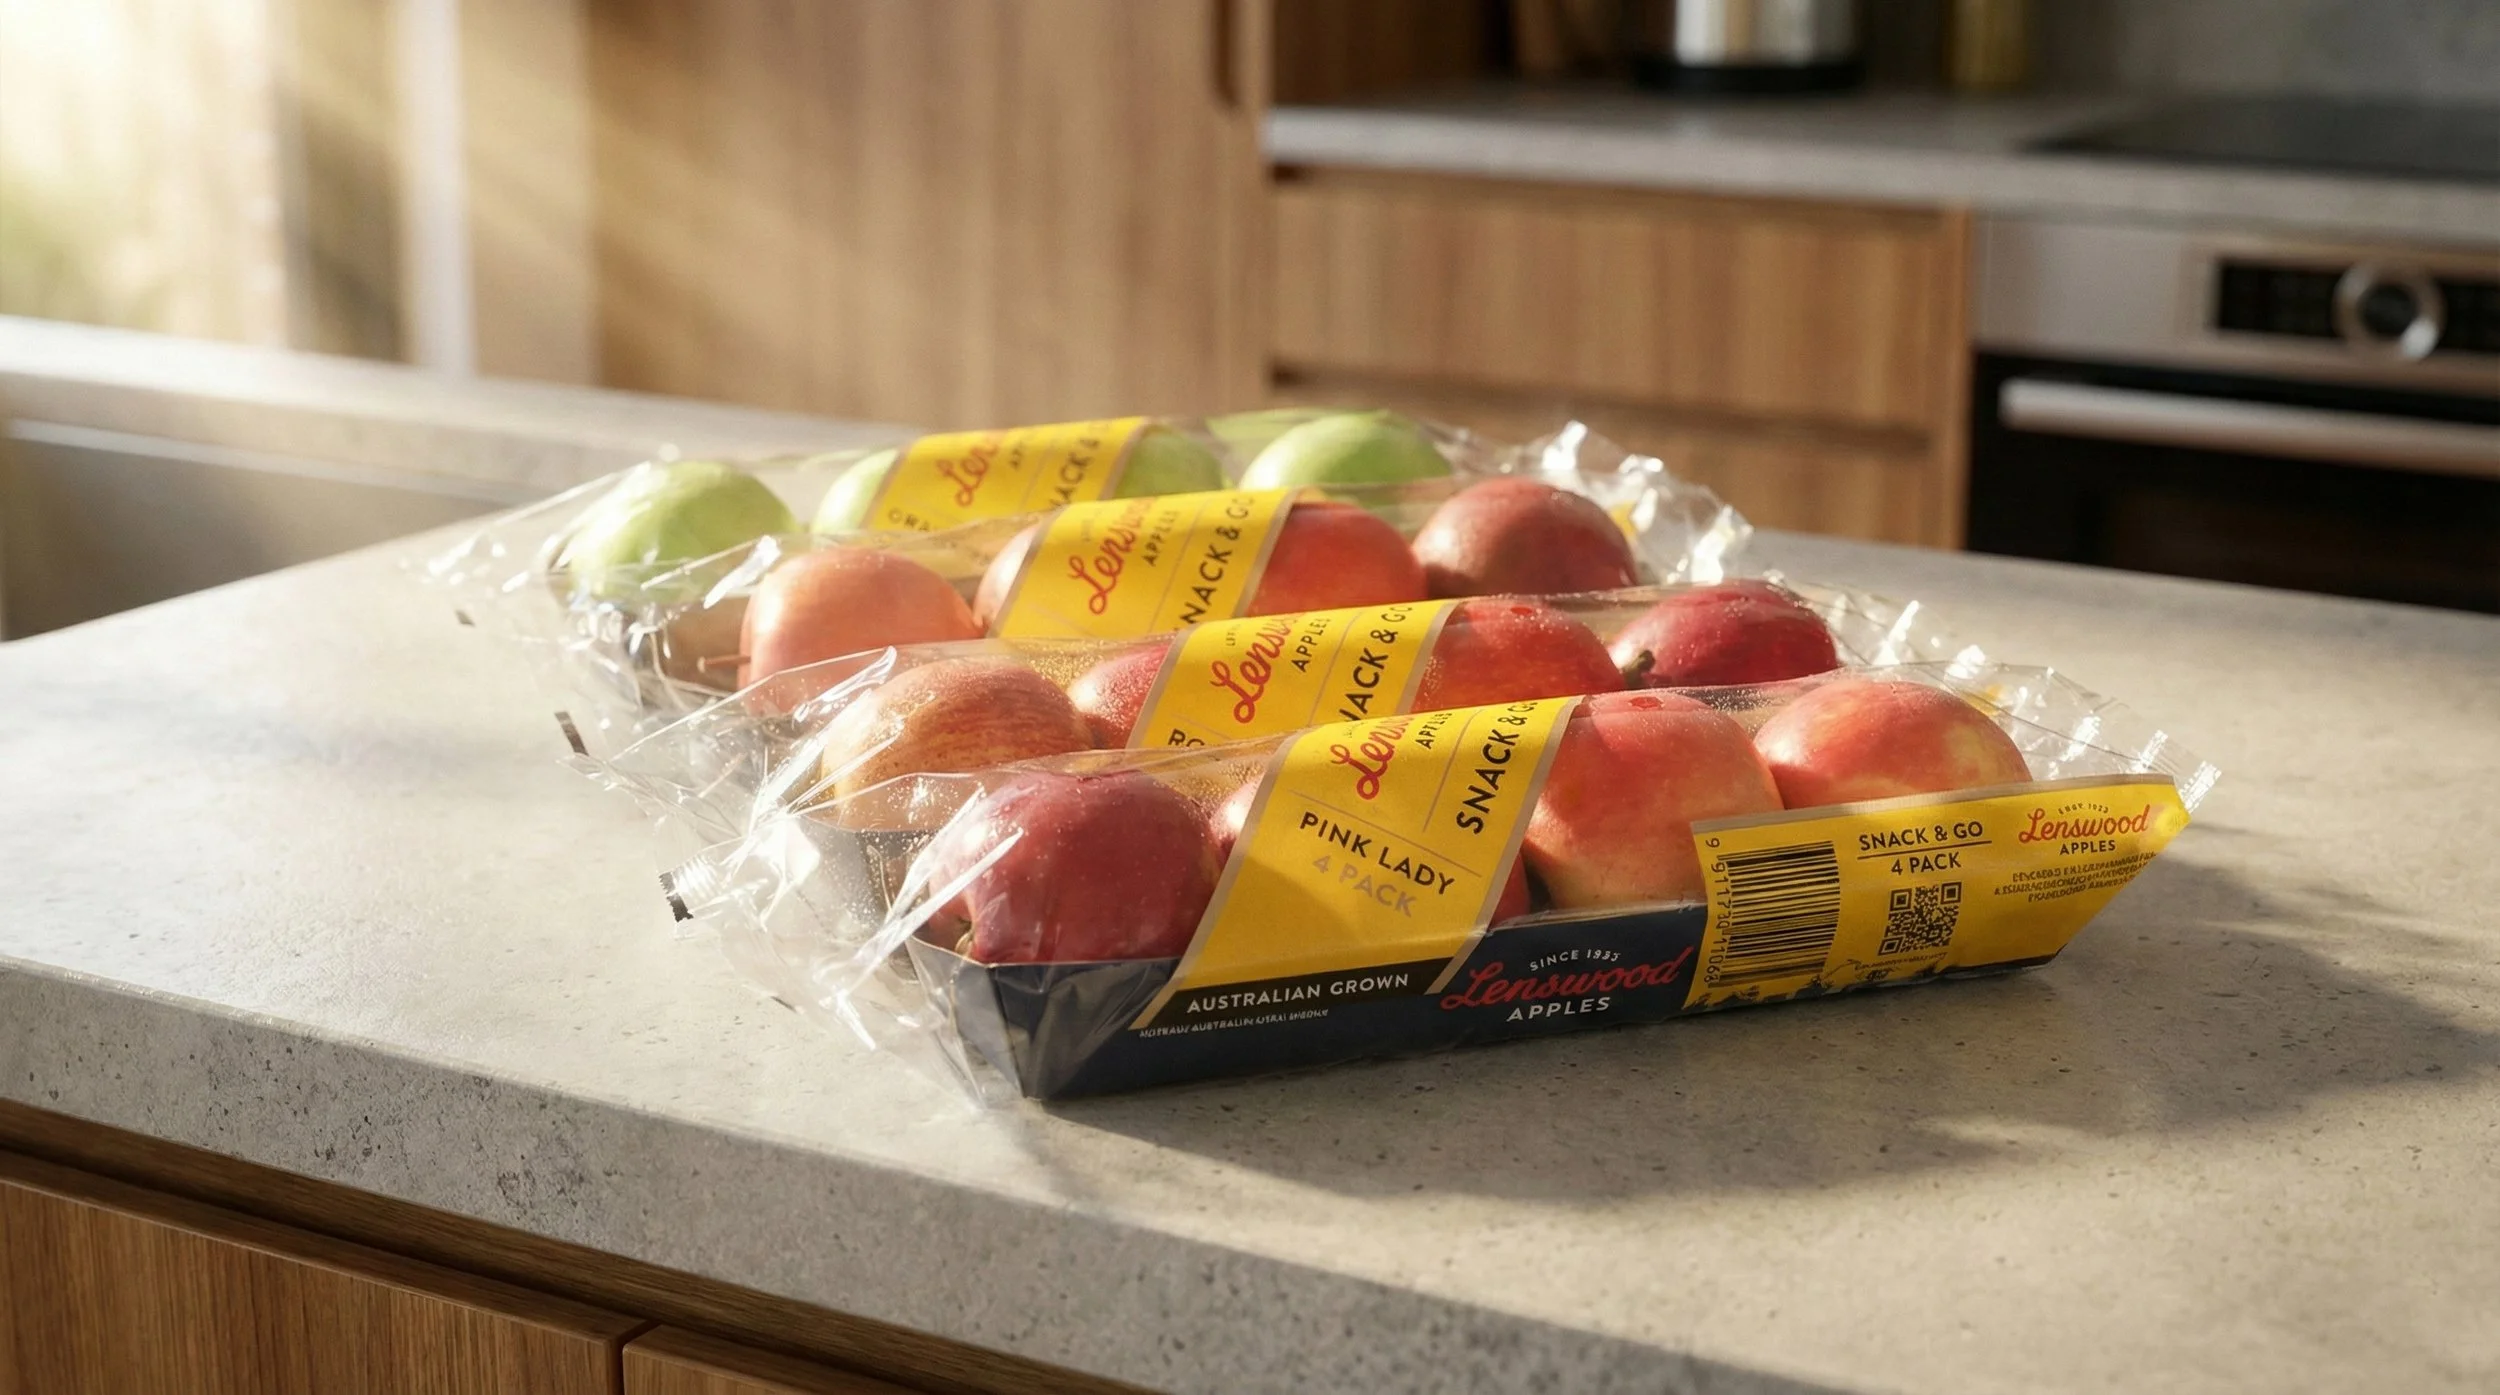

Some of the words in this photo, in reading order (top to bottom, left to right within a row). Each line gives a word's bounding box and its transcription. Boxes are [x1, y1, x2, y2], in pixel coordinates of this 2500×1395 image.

[1174, 544, 1233, 631] NACK
[1216, 526, 1241, 541] &
[1370, 629, 1399, 644] &
[1456, 729, 1520, 835] SNACK
[1498, 715, 1528, 726] &
[1858, 827, 1929, 851] SNACK
[1934, 825, 1948, 841] &
[1953, 821, 1983, 839] GO
[2018, 804, 2151, 844] Lenswood
[1300, 811, 1372, 858] PINK
[1378, 846, 1455, 895] LADY
[1891, 858, 1903, 875] 4
[1909, 852, 1961, 873] PACK
[2059, 840, 2116, 856] APPLES
[1312, 855, 1331, 873] 4
[1339, 862, 1417, 918] PACK
[1440, 946, 1694, 1010] Lenswood
[1529, 949, 1579, 971] SINCE
[1187, 984, 1320, 1014] AUSTRALIAN
[1330, 973, 1409, 995] GROWN
[1506, 996, 1611, 1022] APPLES
